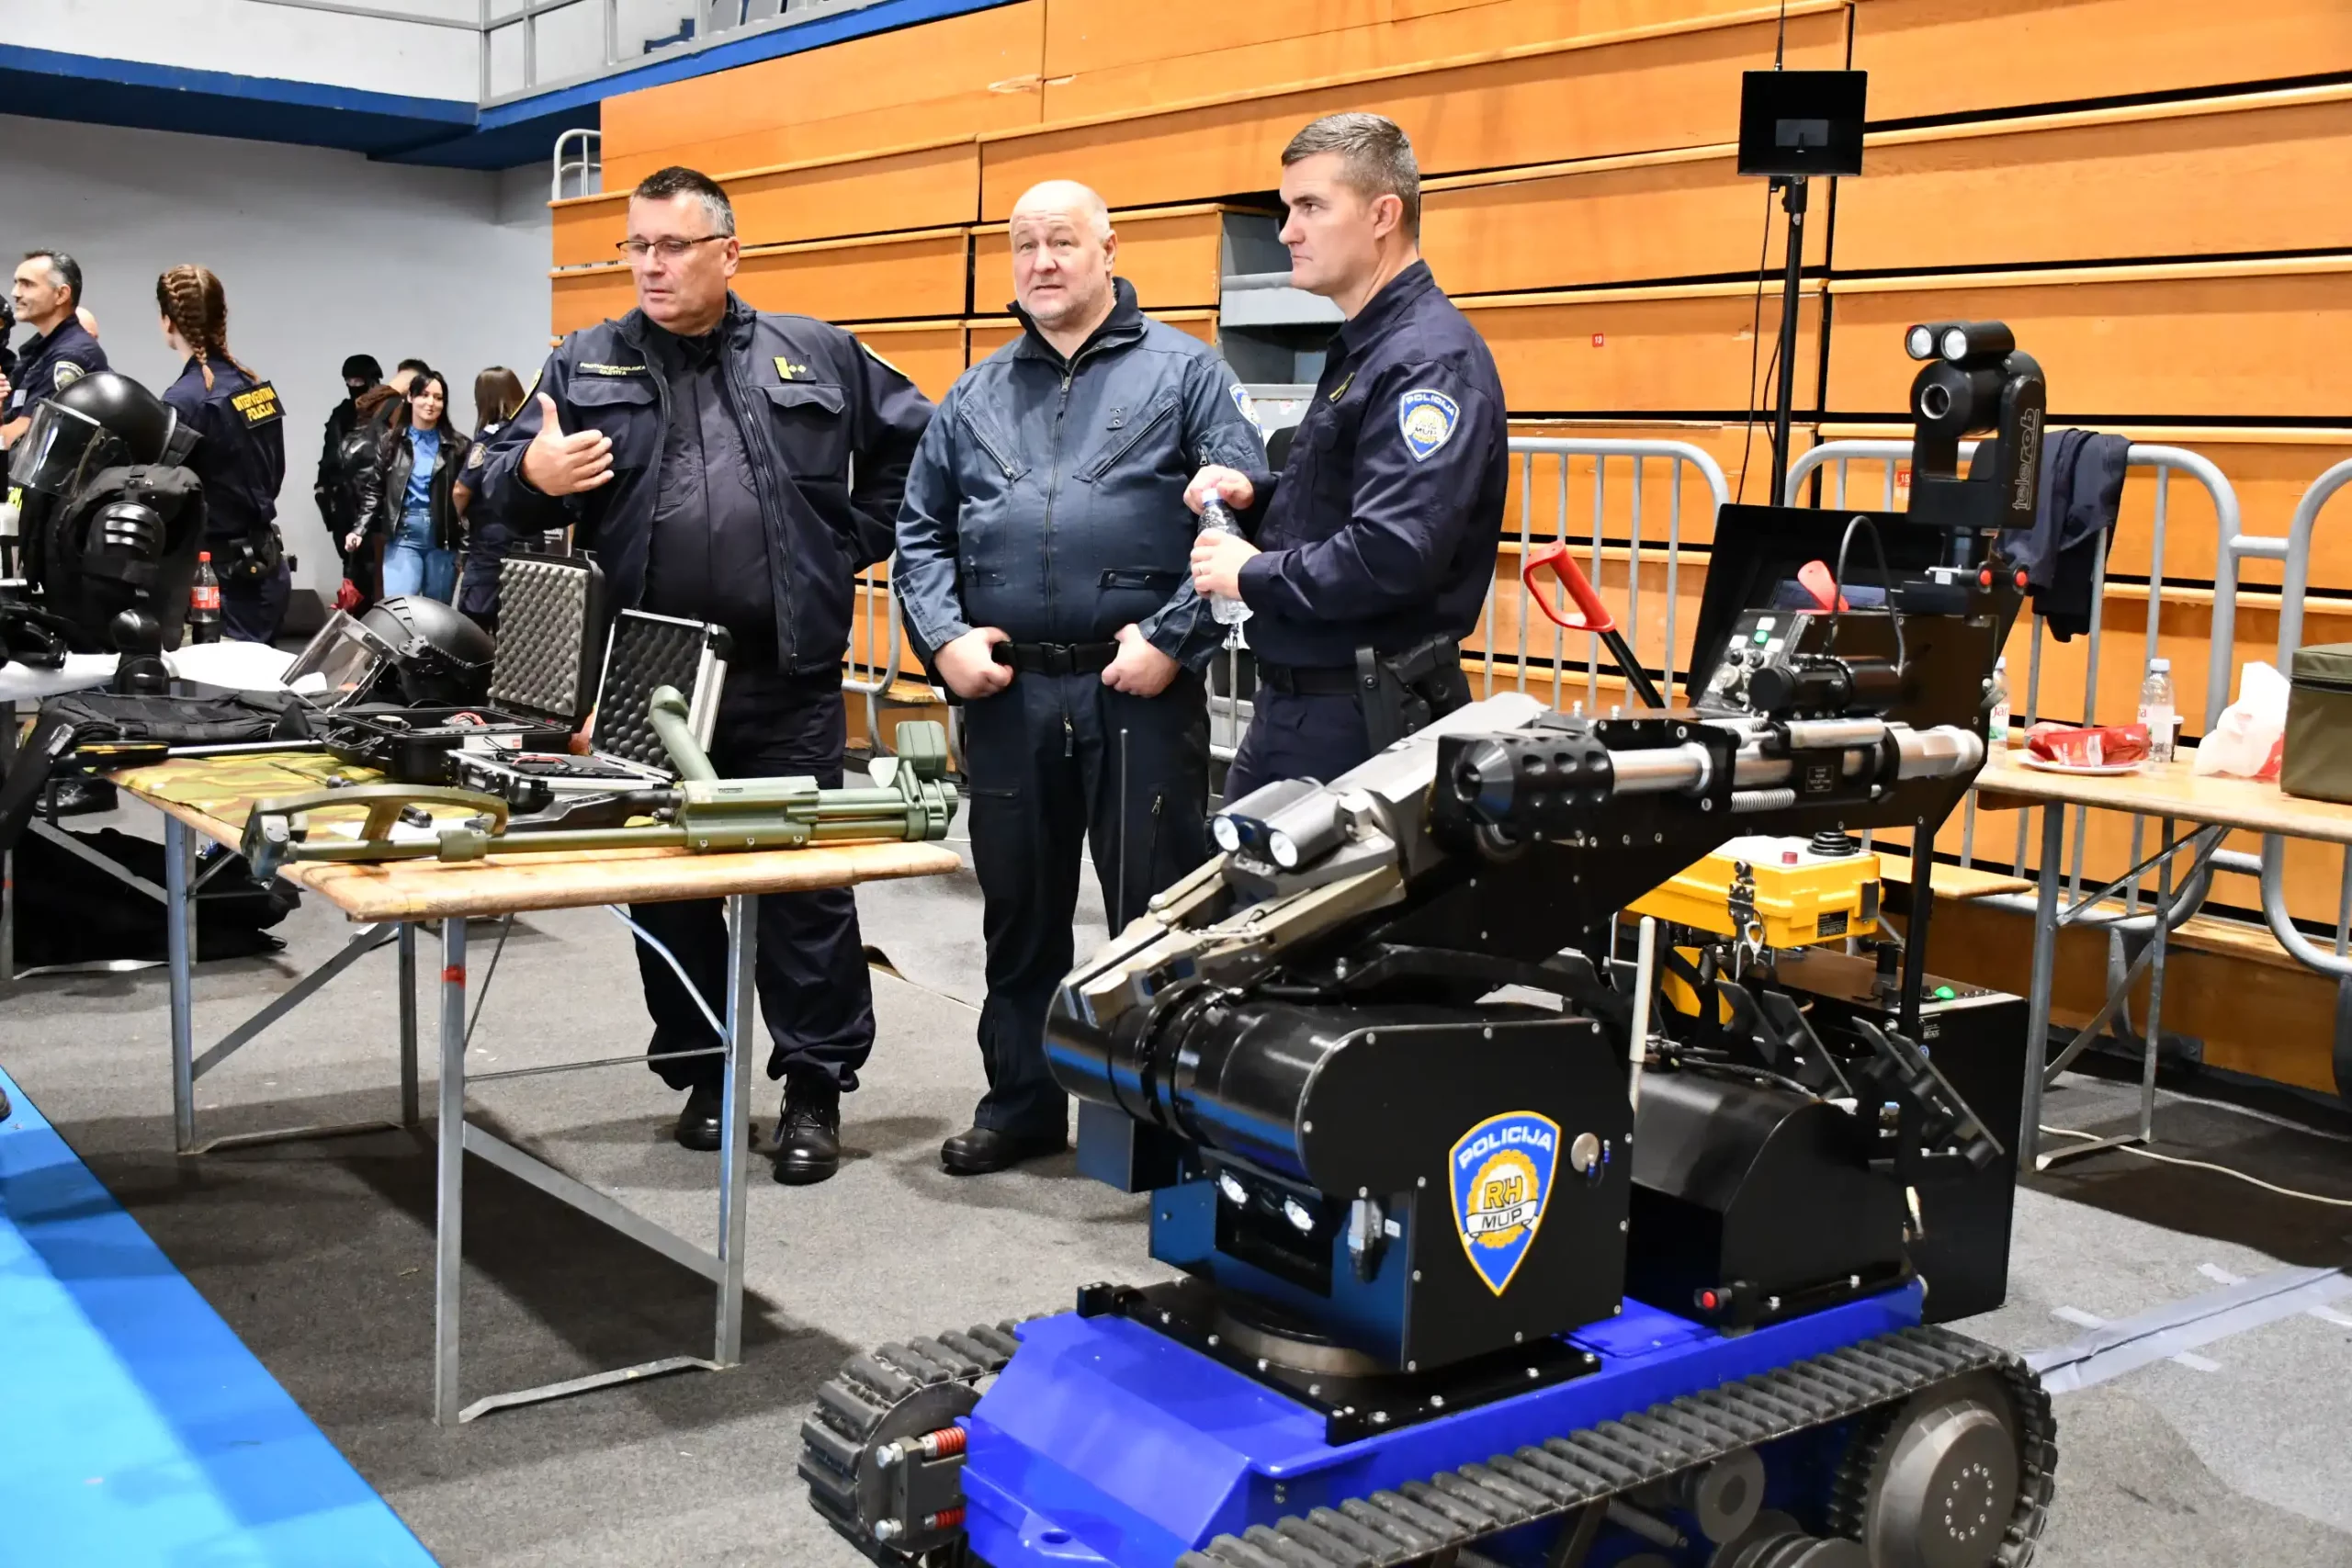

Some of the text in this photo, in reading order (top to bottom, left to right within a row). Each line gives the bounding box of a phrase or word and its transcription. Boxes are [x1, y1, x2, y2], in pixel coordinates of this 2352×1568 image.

[1405, 393, 1454, 416] POLICIJA
[2012, 408, 2035, 511] telerob
[1457, 1125, 1553, 1170] POLICIJA
[1483, 1175, 1524, 1210] RH
[1481, 1208, 1523, 1230] MUP
